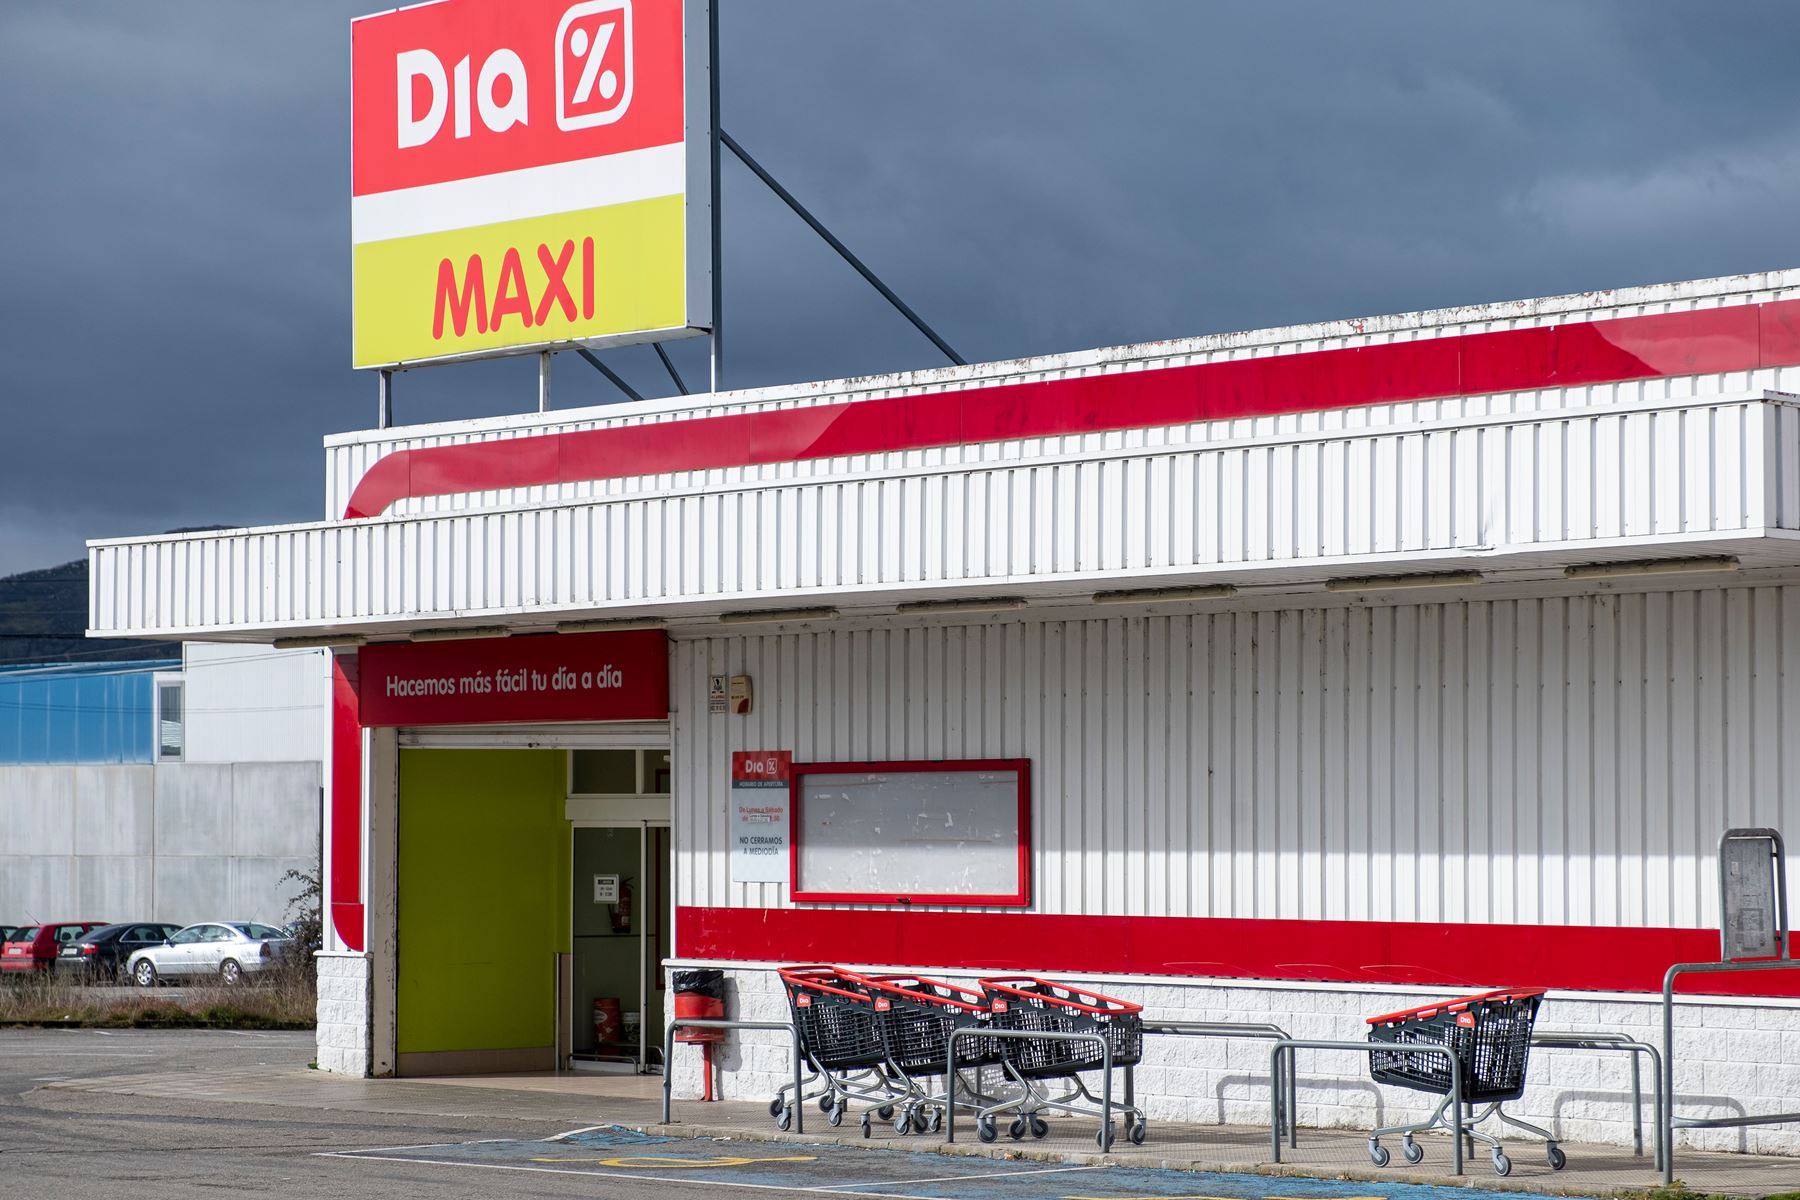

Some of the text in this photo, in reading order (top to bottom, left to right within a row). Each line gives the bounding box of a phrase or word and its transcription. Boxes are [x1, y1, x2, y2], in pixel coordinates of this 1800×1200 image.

[432, 236, 595, 341] MAXI
[386, 663, 622, 697] Hacemos más fácil tu día a día
[739, 836, 783, 845] NO CERRAMOS
[743, 847, 748, 855] A
